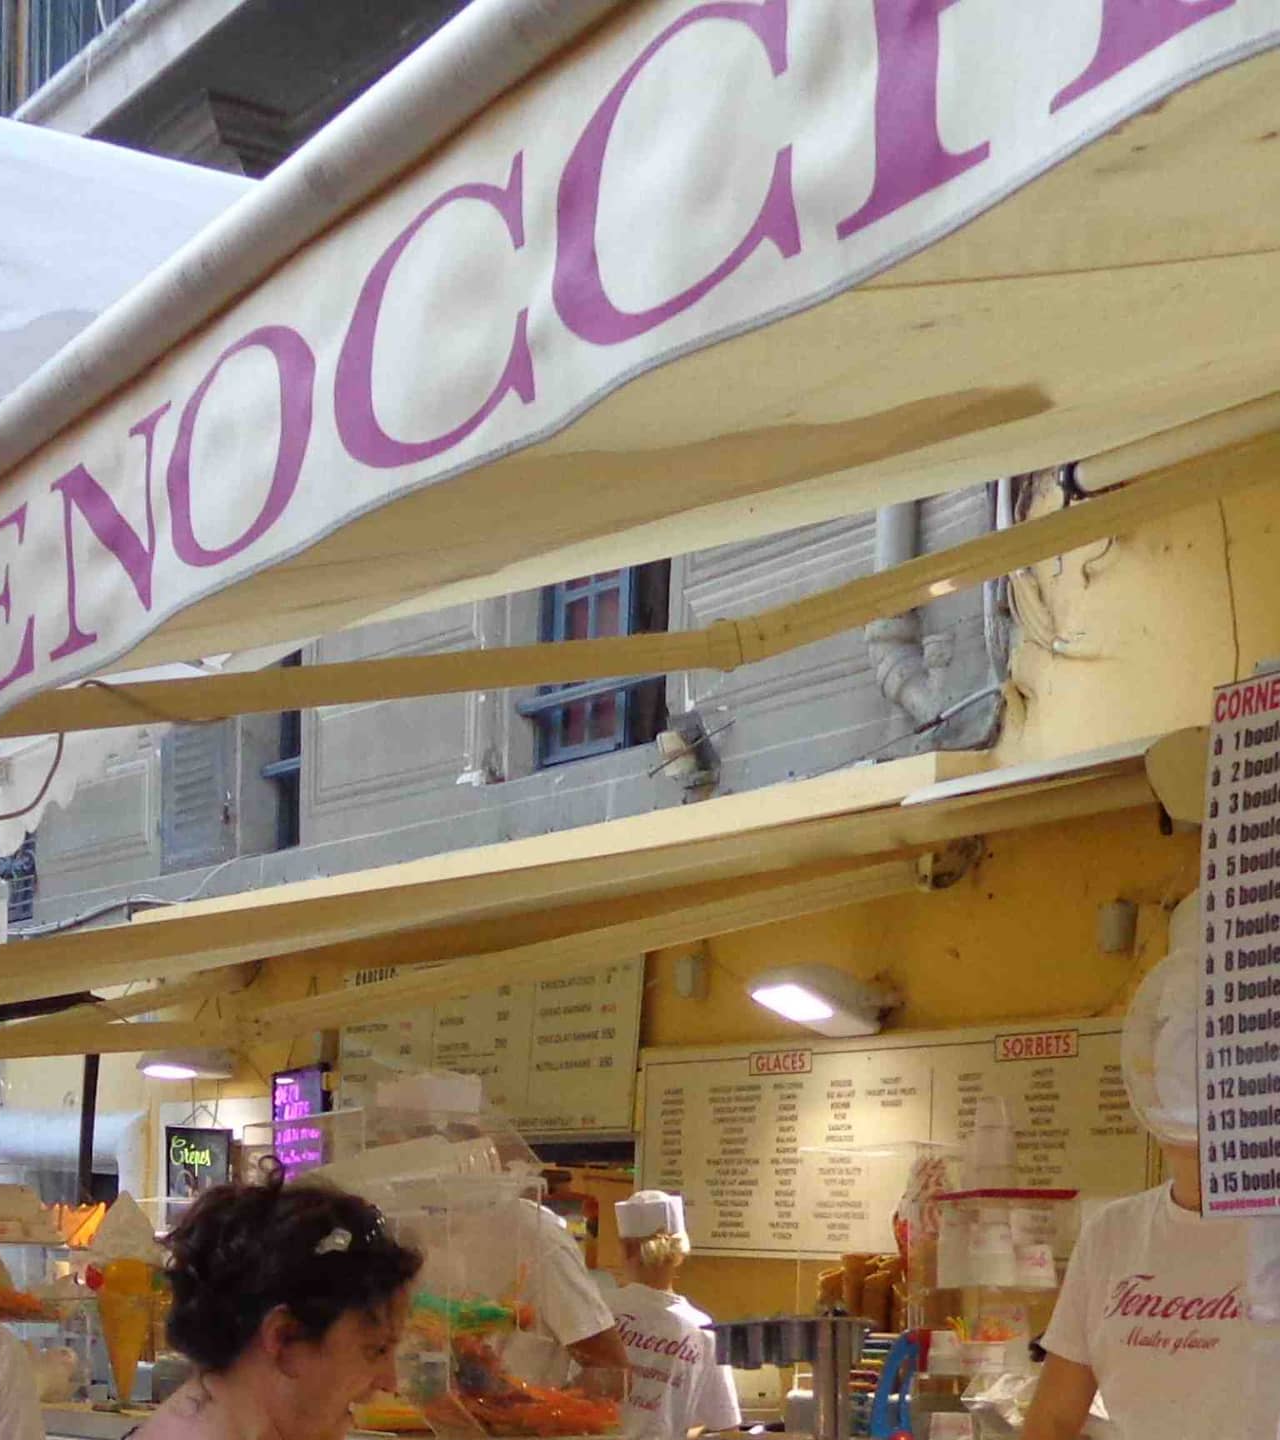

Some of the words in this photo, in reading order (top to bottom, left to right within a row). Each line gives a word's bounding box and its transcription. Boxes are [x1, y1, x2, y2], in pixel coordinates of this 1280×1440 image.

[1234, 731, 1240, 751] 1
[1231, 762, 1240, 783] 2
[1229, 793, 1238, 814] 3
[1227, 825, 1236, 845] 4
[1226, 856, 1236, 877] 5
[1225, 888, 1235, 908] 6
[1225, 919, 1232, 940] 7
[1224, 951, 1233, 972] 8
[1224, 982, 1234, 1003] 9
[1219, 1014, 1234, 1035] 10
[1002, 1035, 1071, 1058] SORBETS
[1219, 1046, 1231, 1067] 11
[755, 1053, 807, 1073] GLACES
[1219, 1078, 1234, 1099] 12
[1220, 1109, 1235, 1129] 13
[1222, 1140, 1236, 1161] 14
[1222, 1171, 1238, 1193] 15
